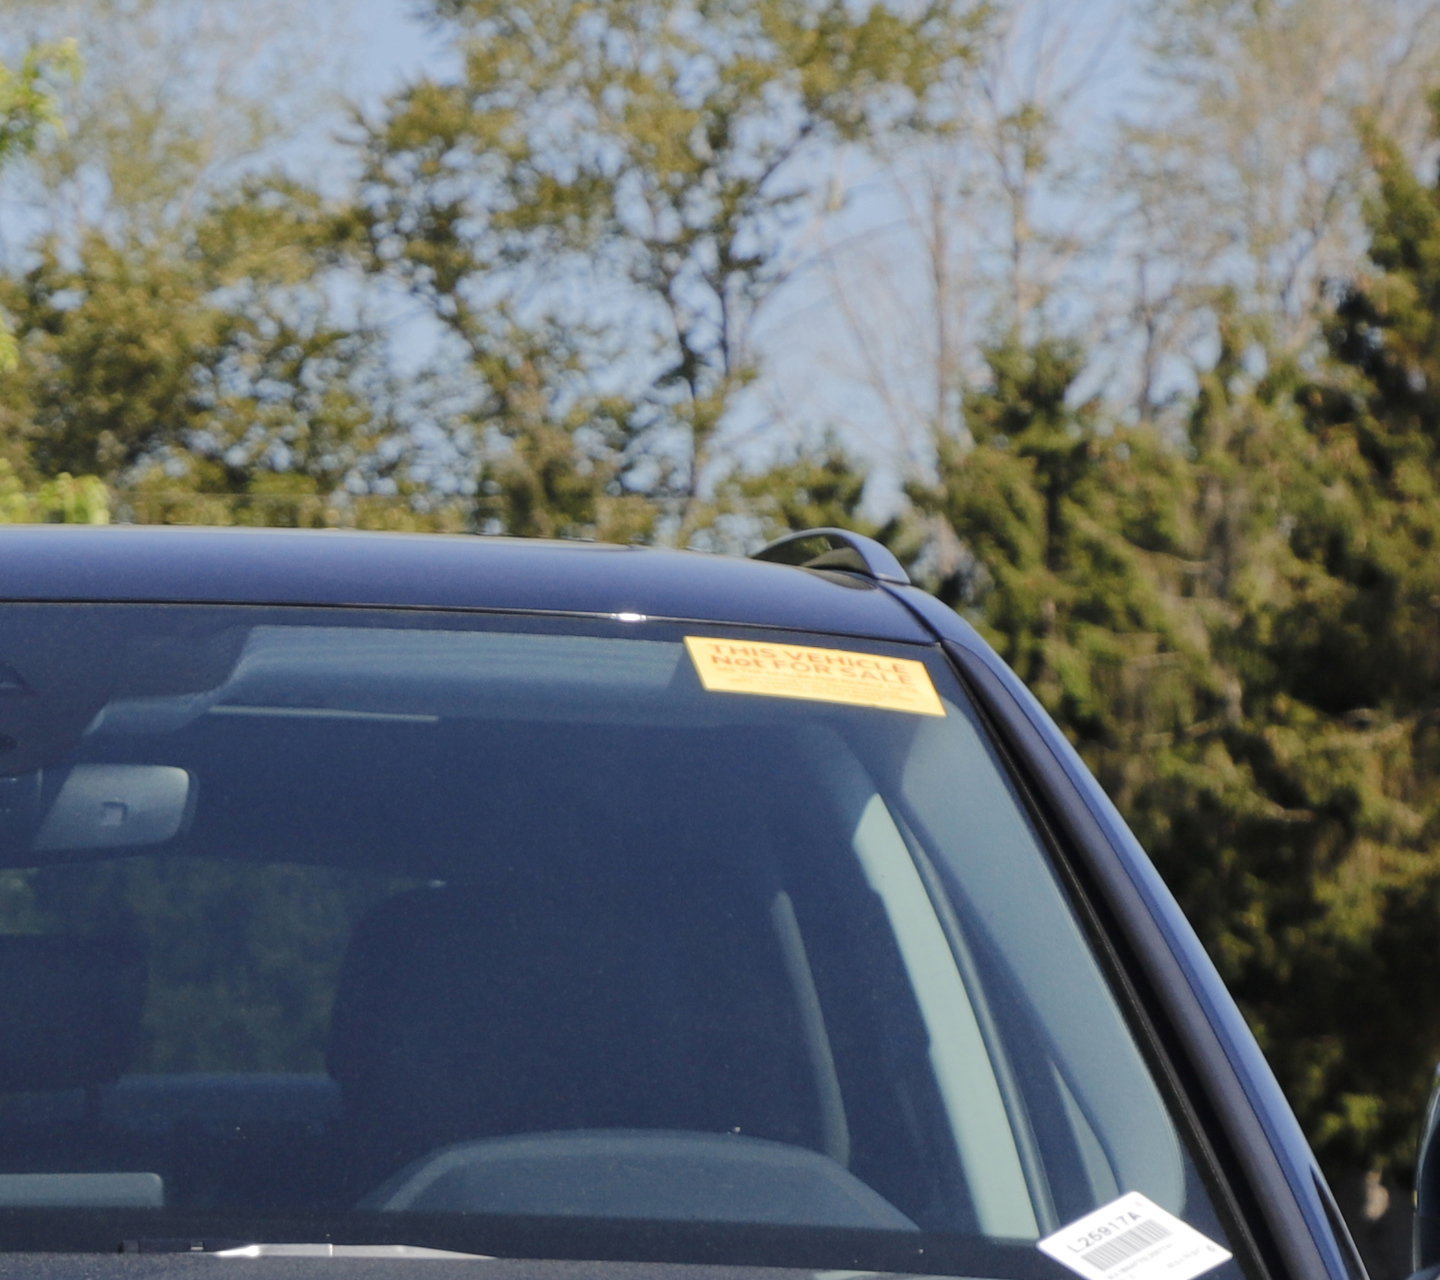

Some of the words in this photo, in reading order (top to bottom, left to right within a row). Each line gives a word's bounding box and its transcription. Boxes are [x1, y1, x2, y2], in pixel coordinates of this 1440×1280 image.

[708, 643, 776, 659] THIS
[782, 648, 908, 673] VEHICLE
[772, 659, 832, 675] FOR
[840, 667, 913, 685] SALE
